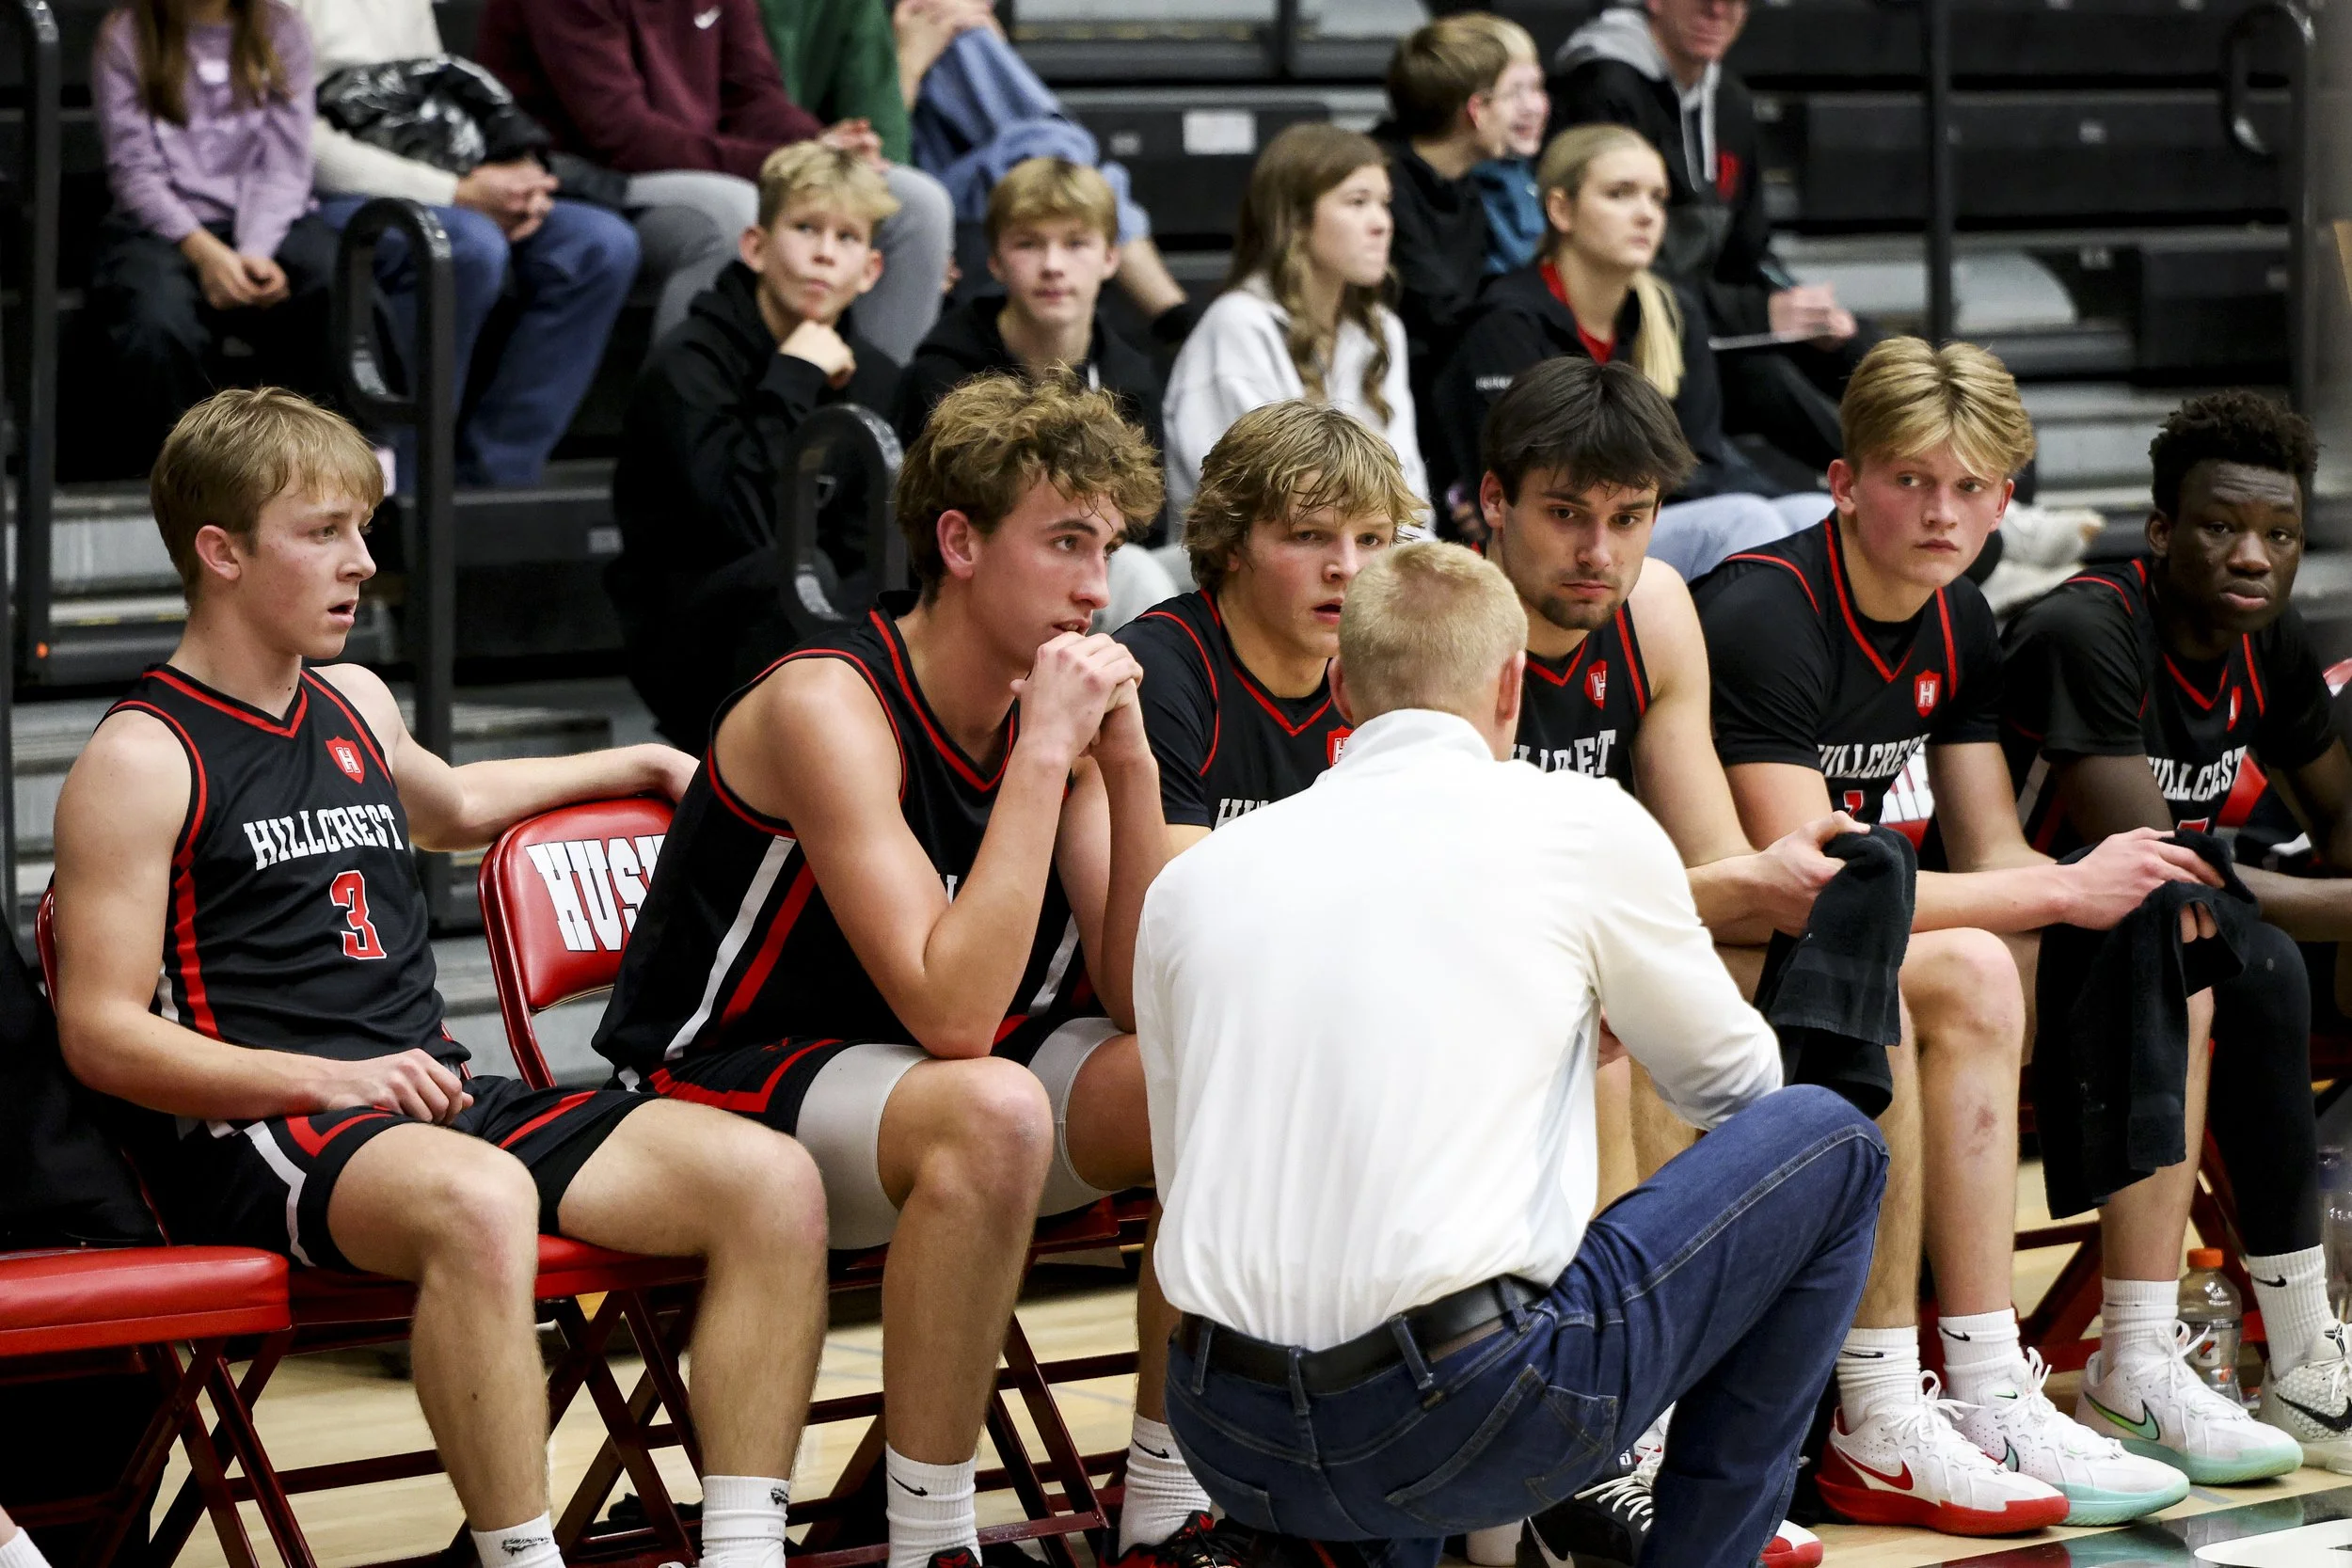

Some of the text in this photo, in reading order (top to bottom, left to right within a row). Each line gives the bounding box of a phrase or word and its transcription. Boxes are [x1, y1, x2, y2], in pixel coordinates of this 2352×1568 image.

[1918, 680, 1936, 707] H
[335, 746, 361, 774] H
[243, 803, 405, 871] HILLCREST
[329, 869, 388, 960] 3
